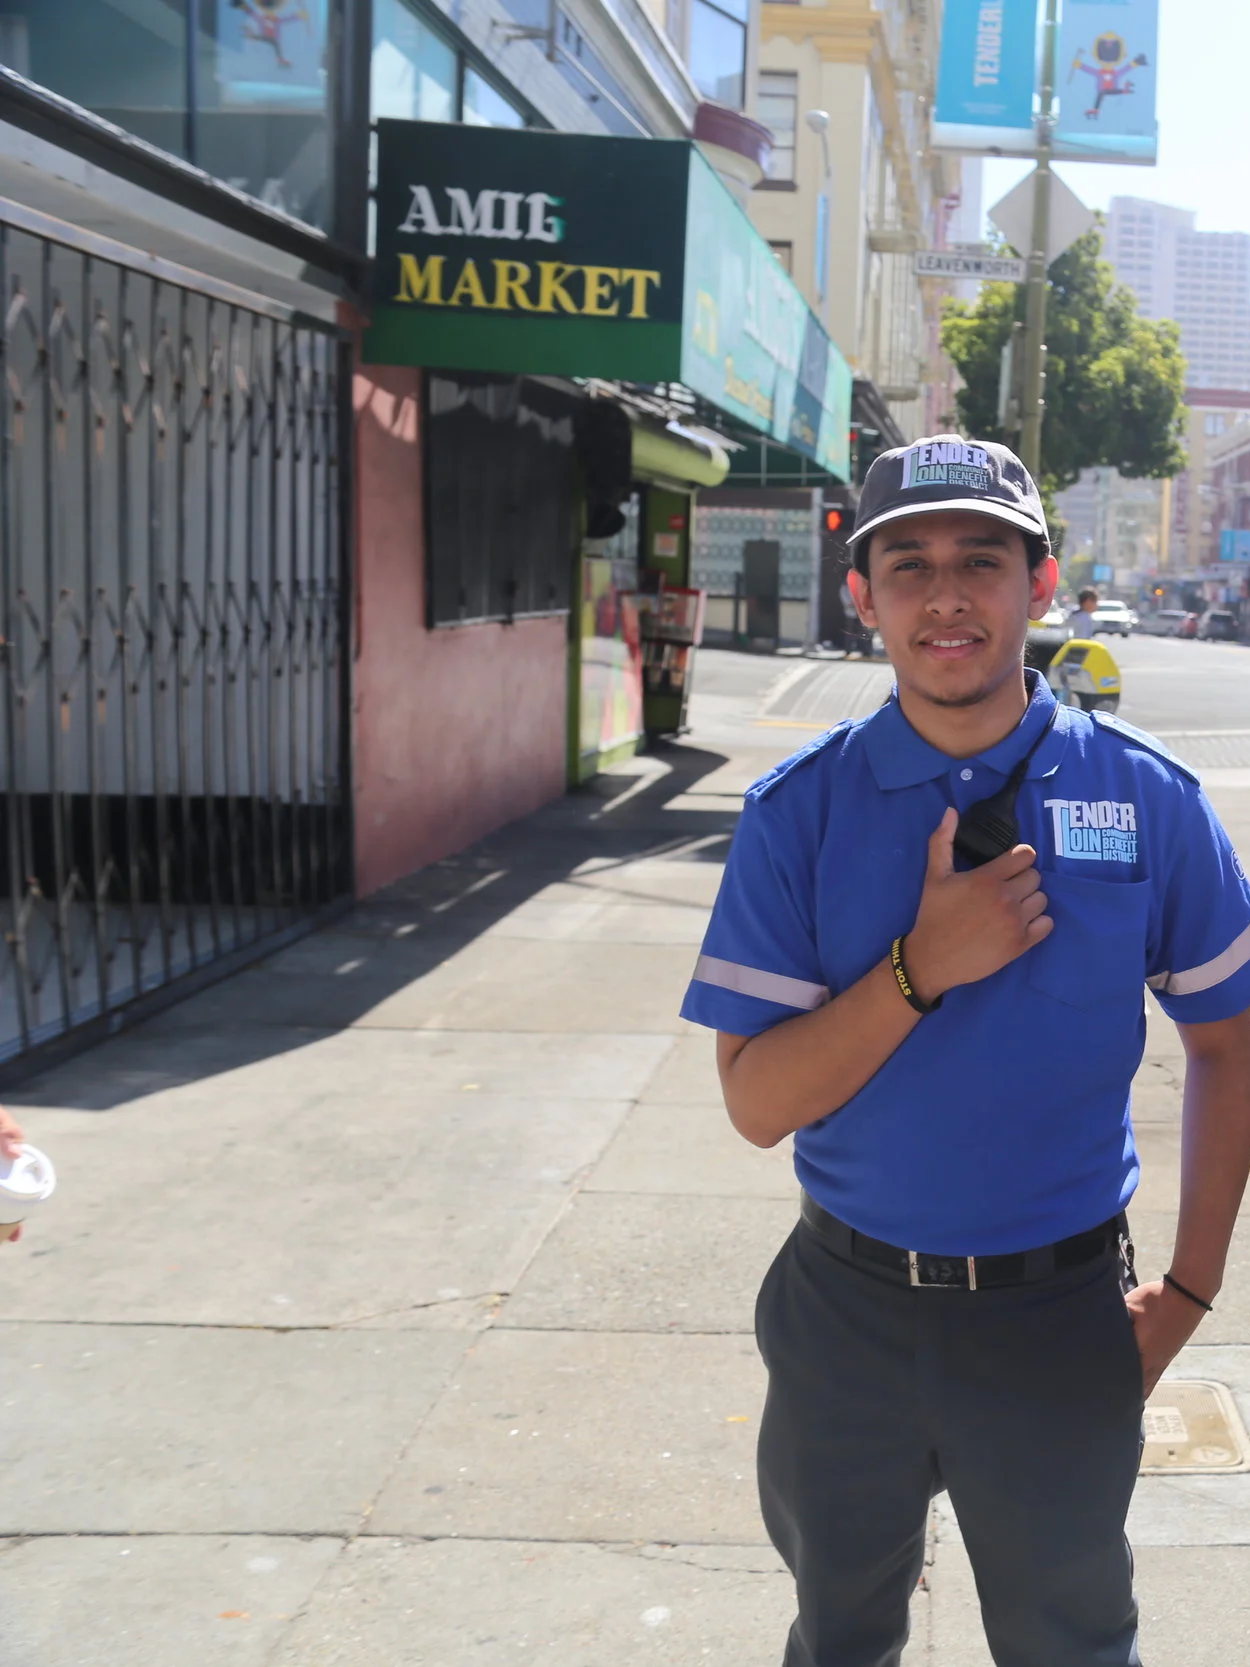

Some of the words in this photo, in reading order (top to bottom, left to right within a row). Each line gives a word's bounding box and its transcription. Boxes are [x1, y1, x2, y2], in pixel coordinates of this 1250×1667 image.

[918, 256, 1020, 276] LEAVENWORTH
[393, 252, 661, 319] MARKET
[897, 442, 989, 490] TENDER
[908, 452, 948, 488] LOIN
[948, 470, 989, 483] BENEFIT
[1044, 798, 1137, 856] TENDER
[1061, 808, 1102, 861] LOIN
[1101, 829, 1137, 841] COMMUNITY
[1102, 837, 1138, 853] BENEFIT
[1102, 849, 1138, 864] DISTRICT
[896, 967, 911, 995] STOP.
